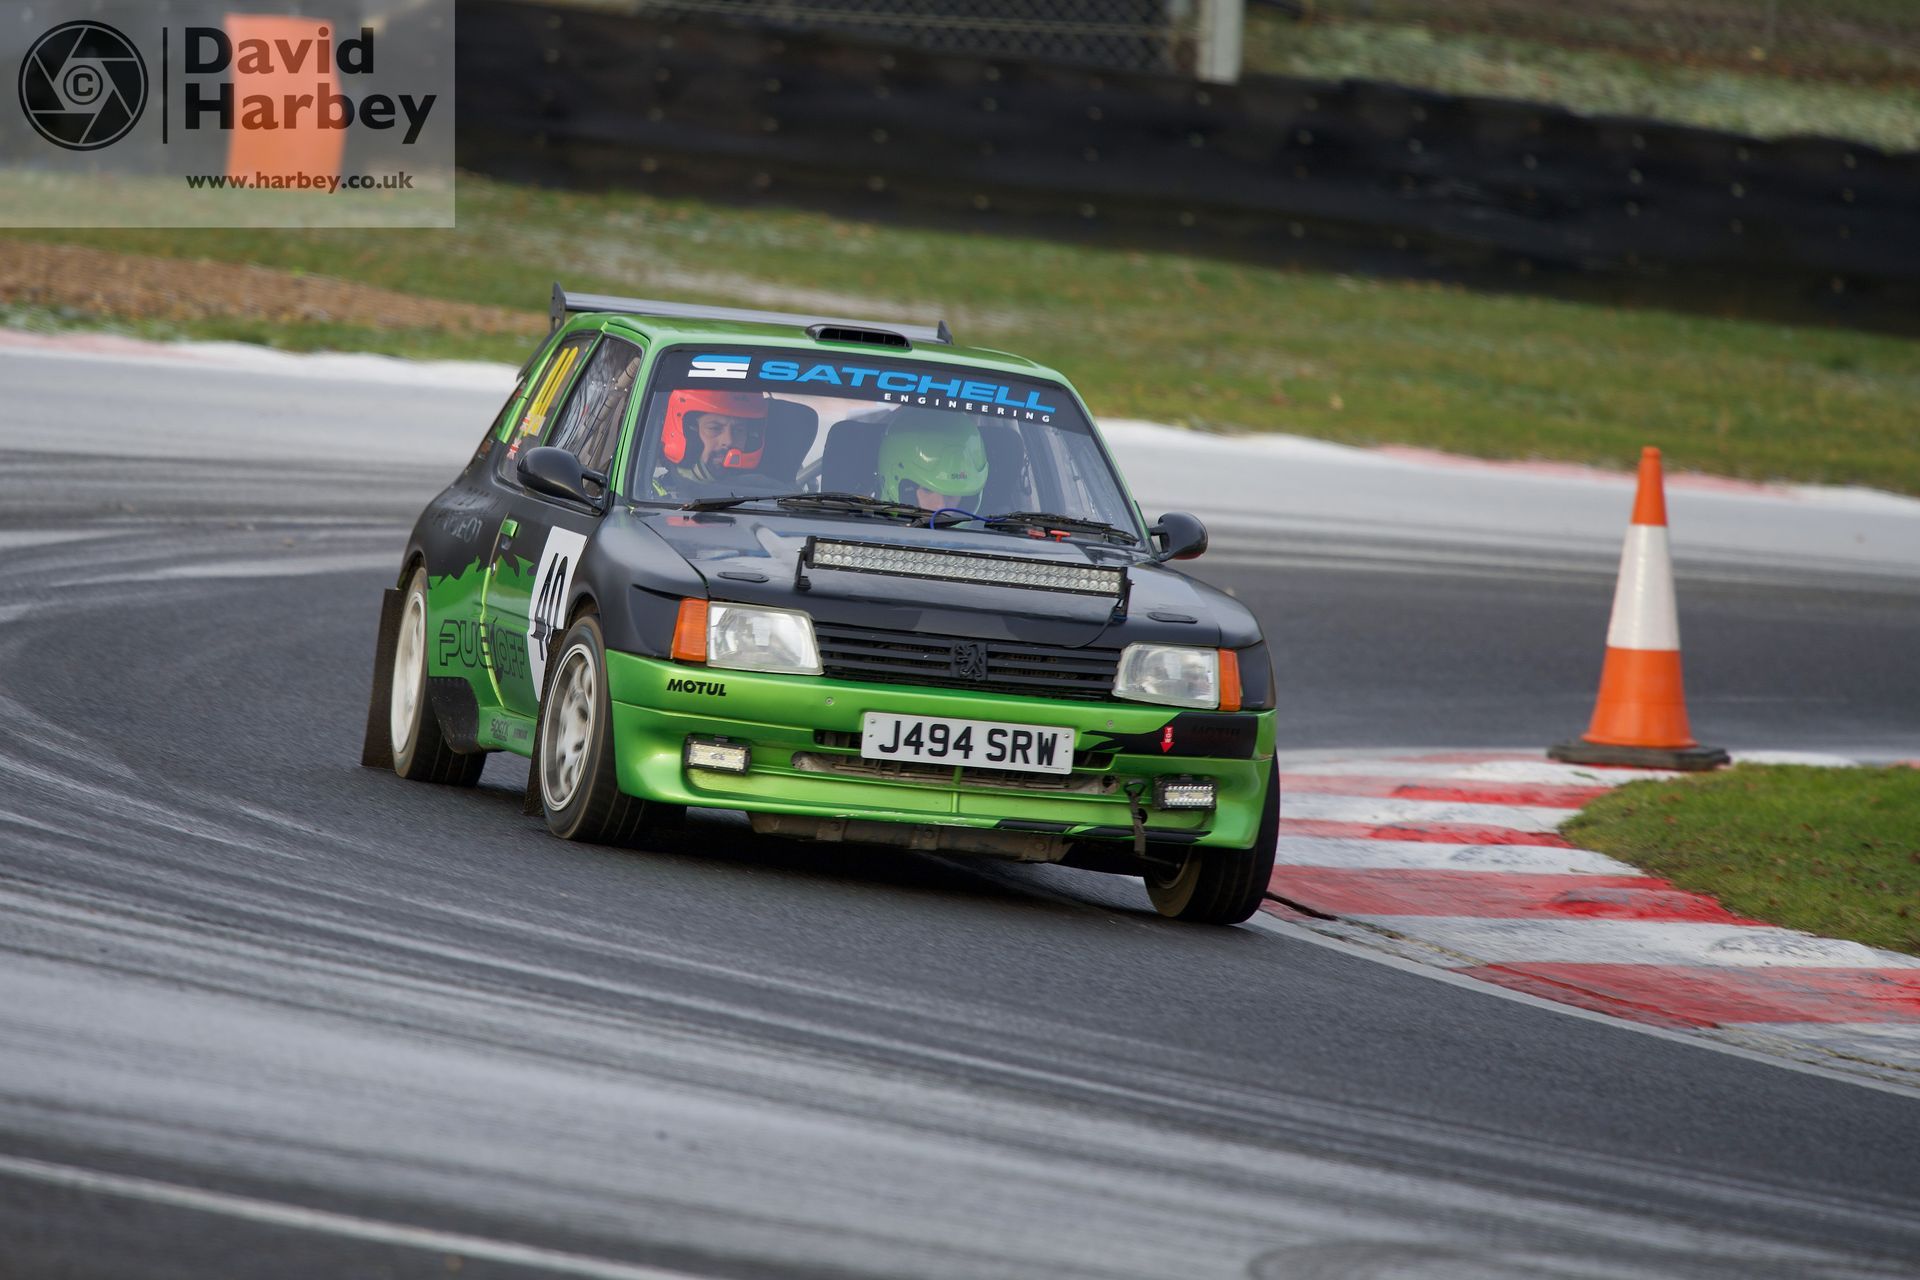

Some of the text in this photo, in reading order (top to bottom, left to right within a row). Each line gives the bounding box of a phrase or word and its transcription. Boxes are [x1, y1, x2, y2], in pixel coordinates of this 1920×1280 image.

[758, 360, 1057, 414] SATCHELL
[884, 392, 1052, 424] ENGINEERING
[666, 678, 727, 697] MOTUL
[879, 720, 1058, 767] J494 SRW
